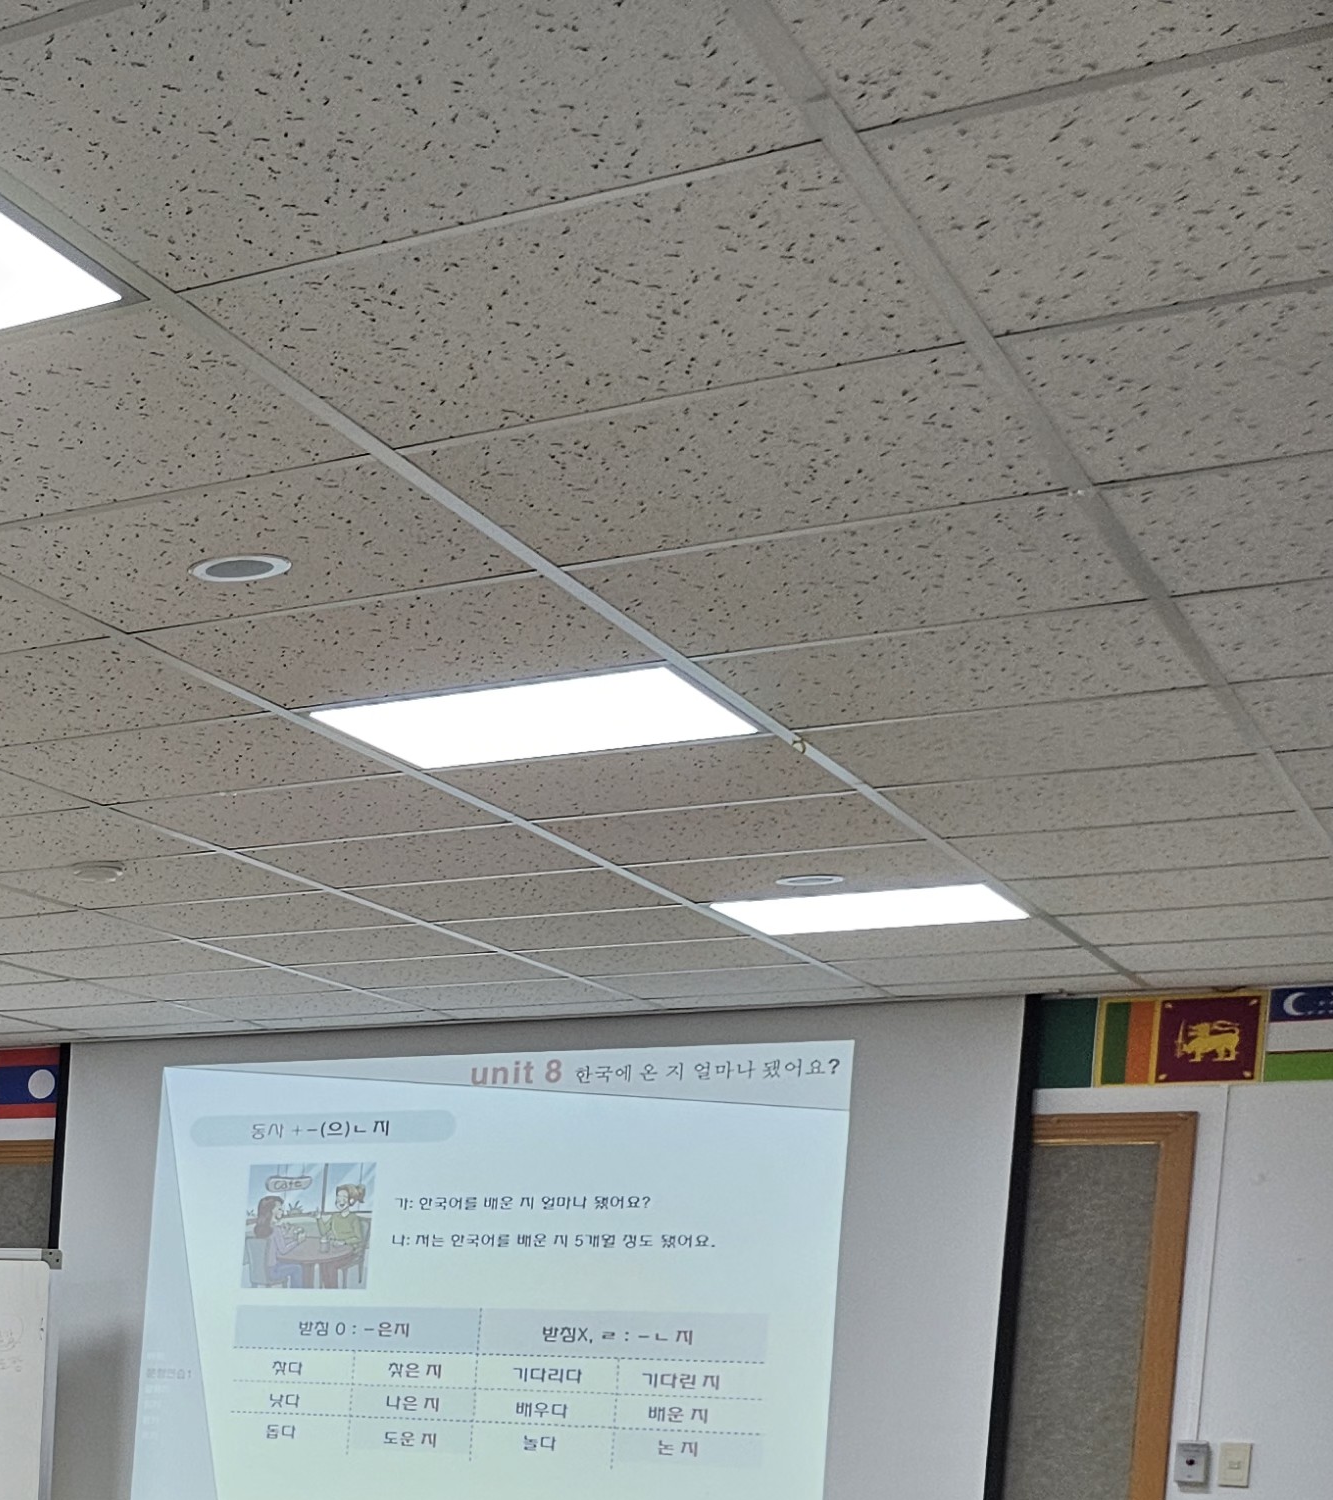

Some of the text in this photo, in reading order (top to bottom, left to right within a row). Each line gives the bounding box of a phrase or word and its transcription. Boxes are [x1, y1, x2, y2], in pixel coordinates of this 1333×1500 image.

[471, 1058, 841, 1086] unit 8 한국에 온 지 얼마나 됐어요?
[251, 1122, 283, 1140] 동사
[373, 1119, 389, 1137] 지
[395, 1197, 414, 1211] 가:
[484, 1196, 513, 1210] 배운
[520, 1197, 534, 1210] 지
[541, 1196, 587, 1210] 얼마나
[392, 1234, 410, 1248] 나:
[415, 1234, 444, 1248] 저는
[517, 1234, 546, 1248] 배운
[553, 1234, 568, 1248] 지
[575, 1234, 616, 1248] 5개월
[299, 1321, 329, 1336] 받침
[676, 1330, 693, 1345] 지
[388, 1362, 442, 1379] 찾은 지
[513, 1367, 582, 1384] 기다리다
[642, 1372, 720, 1390] 기다린 지
[269, 1393, 300, 1408] 낫다
[386, 1395, 440, 1412] 나은 지
[515, 1402, 568, 1419] 배우다
[648, 1406, 708, 1424] 배운 지
[383, 1431, 437, 1448] 도운 지
[523, 1435, 556, 1451] 놀다
[658, 1440, 698, 1457] 논 지
